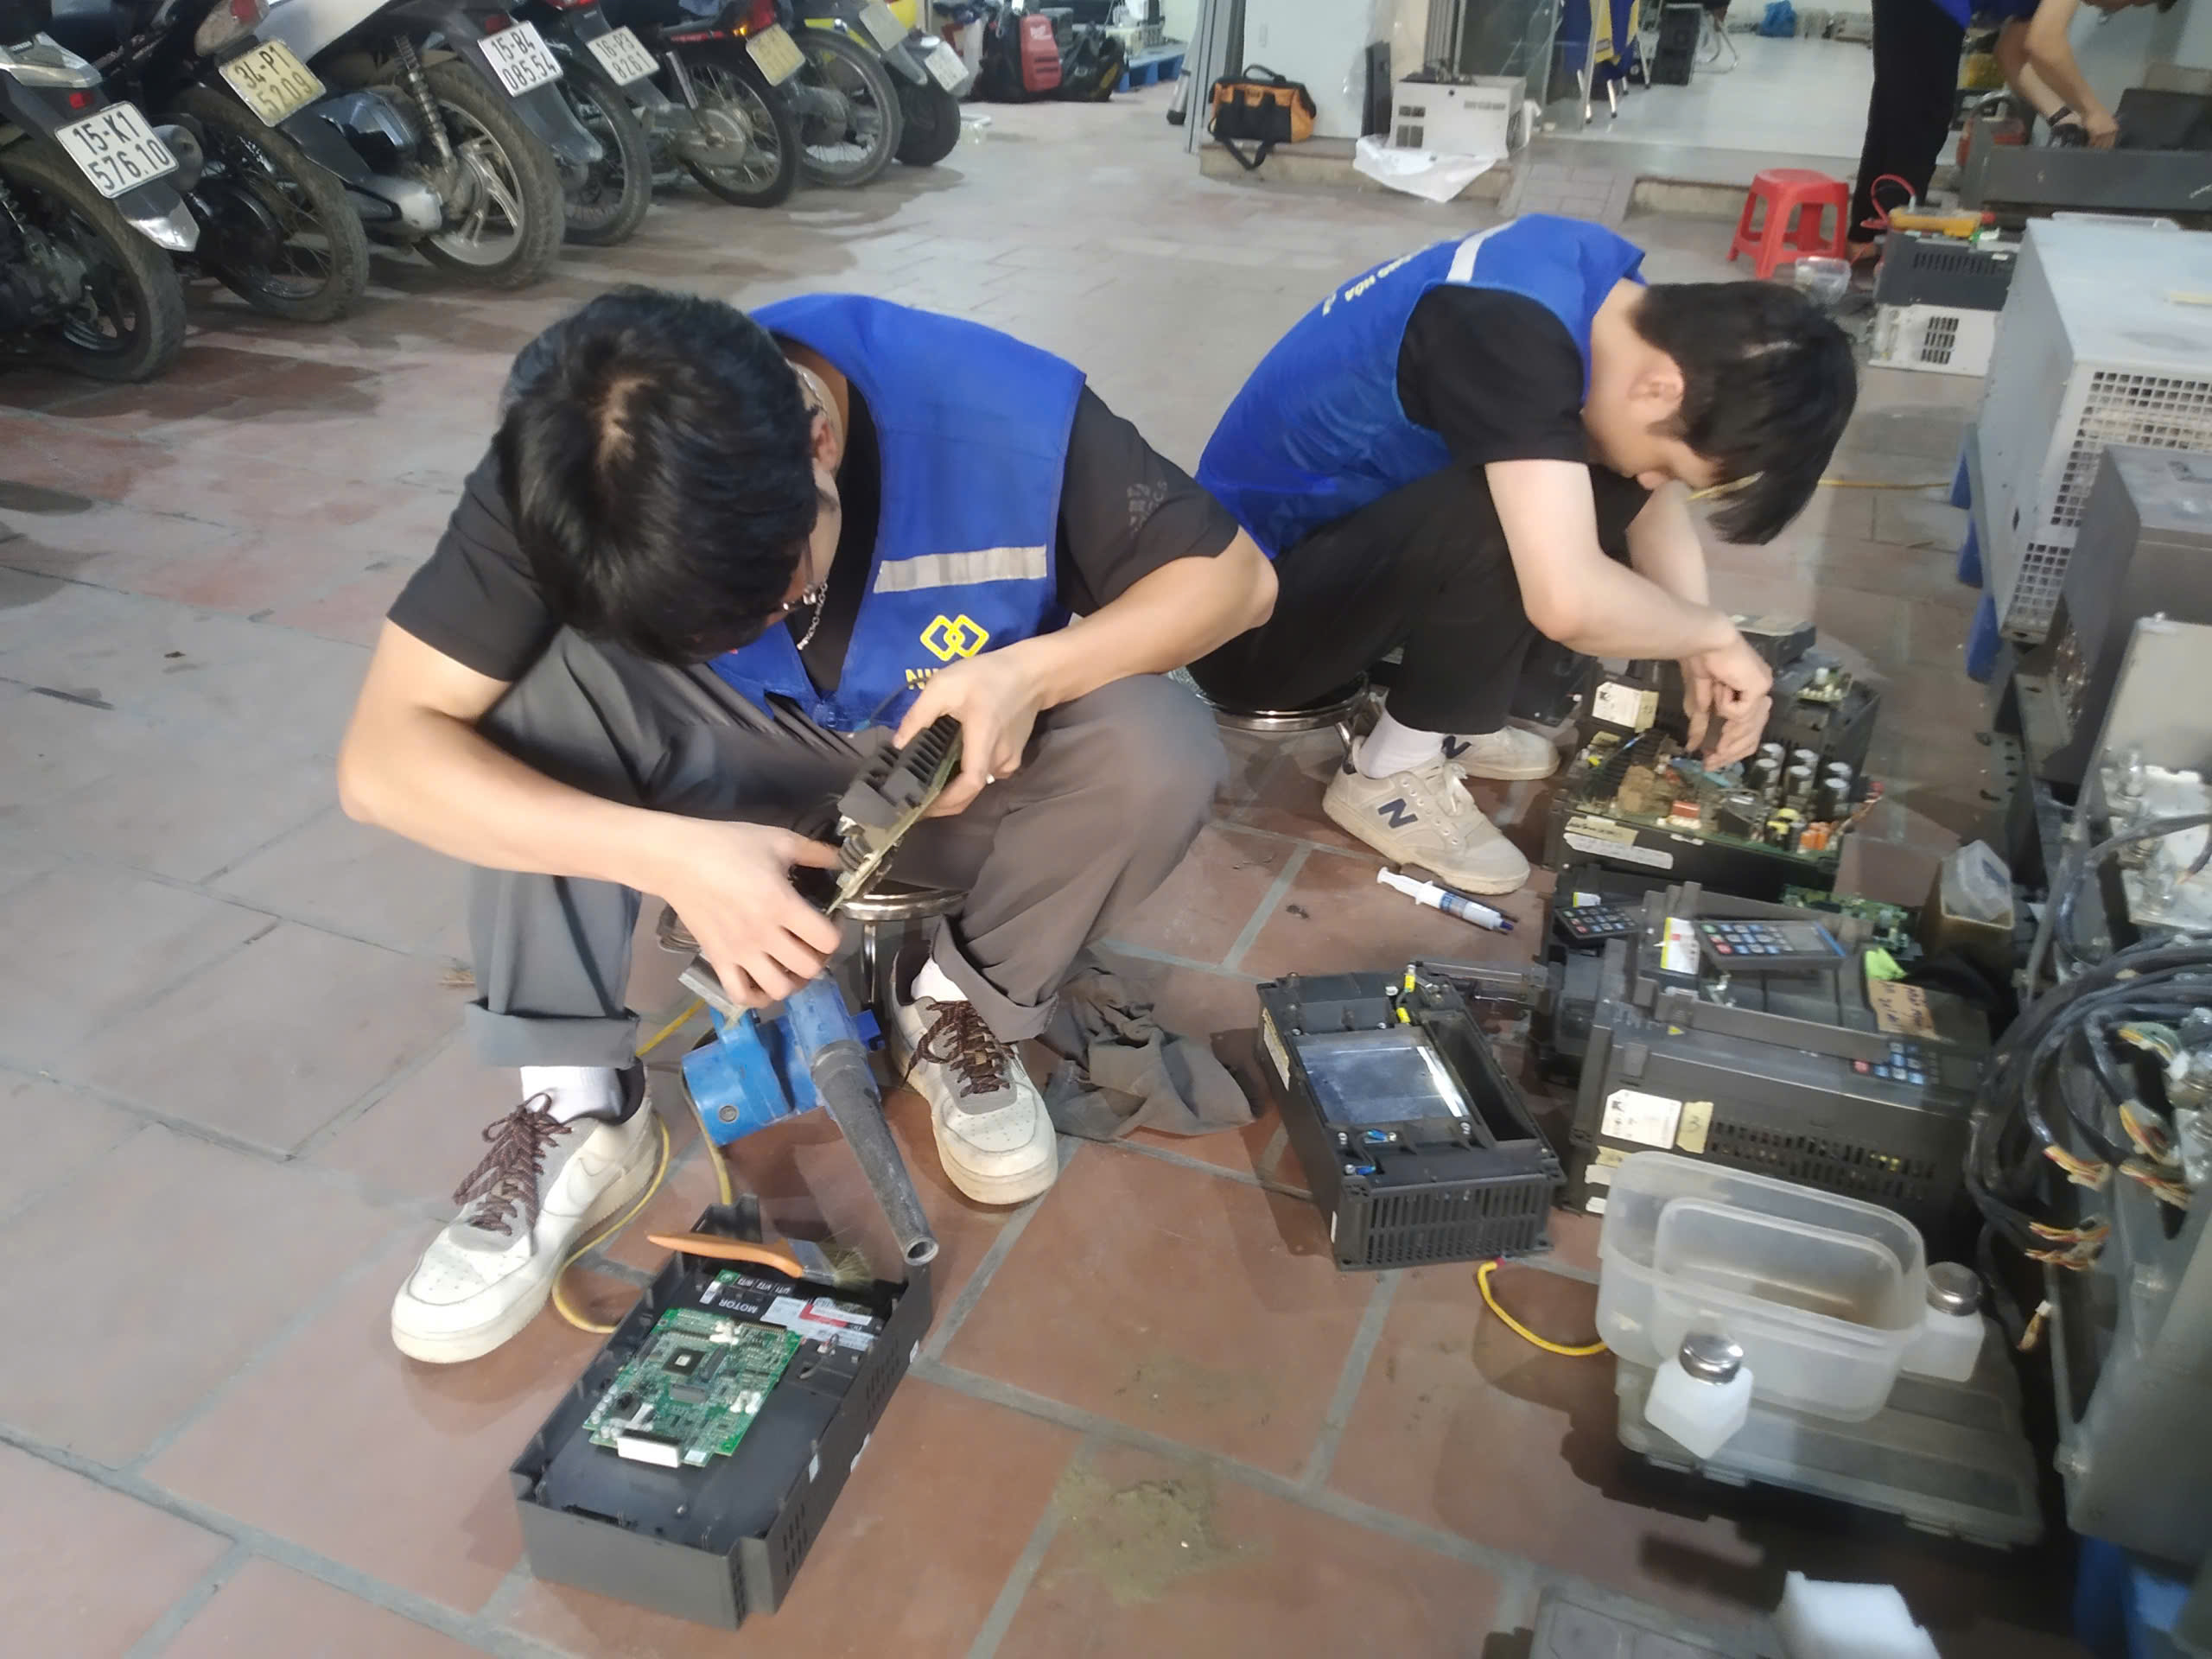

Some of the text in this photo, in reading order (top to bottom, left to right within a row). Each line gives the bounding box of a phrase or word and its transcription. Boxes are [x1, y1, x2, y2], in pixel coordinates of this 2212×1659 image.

[491, 29, 536, 63] 15-B4
[611, 51, 652, 79] 8261
[234, 45, 291, 90] 34-P1
[502, 51, 557, 90] 085.54
[257, 71, 313, 118] 5209
[72, 111, 141, 156] 15-K1
[87, 139, 170, 191] 576.10
[1377, 798, 1419, 829] N
[718, 1298, 759, 1314] MOTOR
